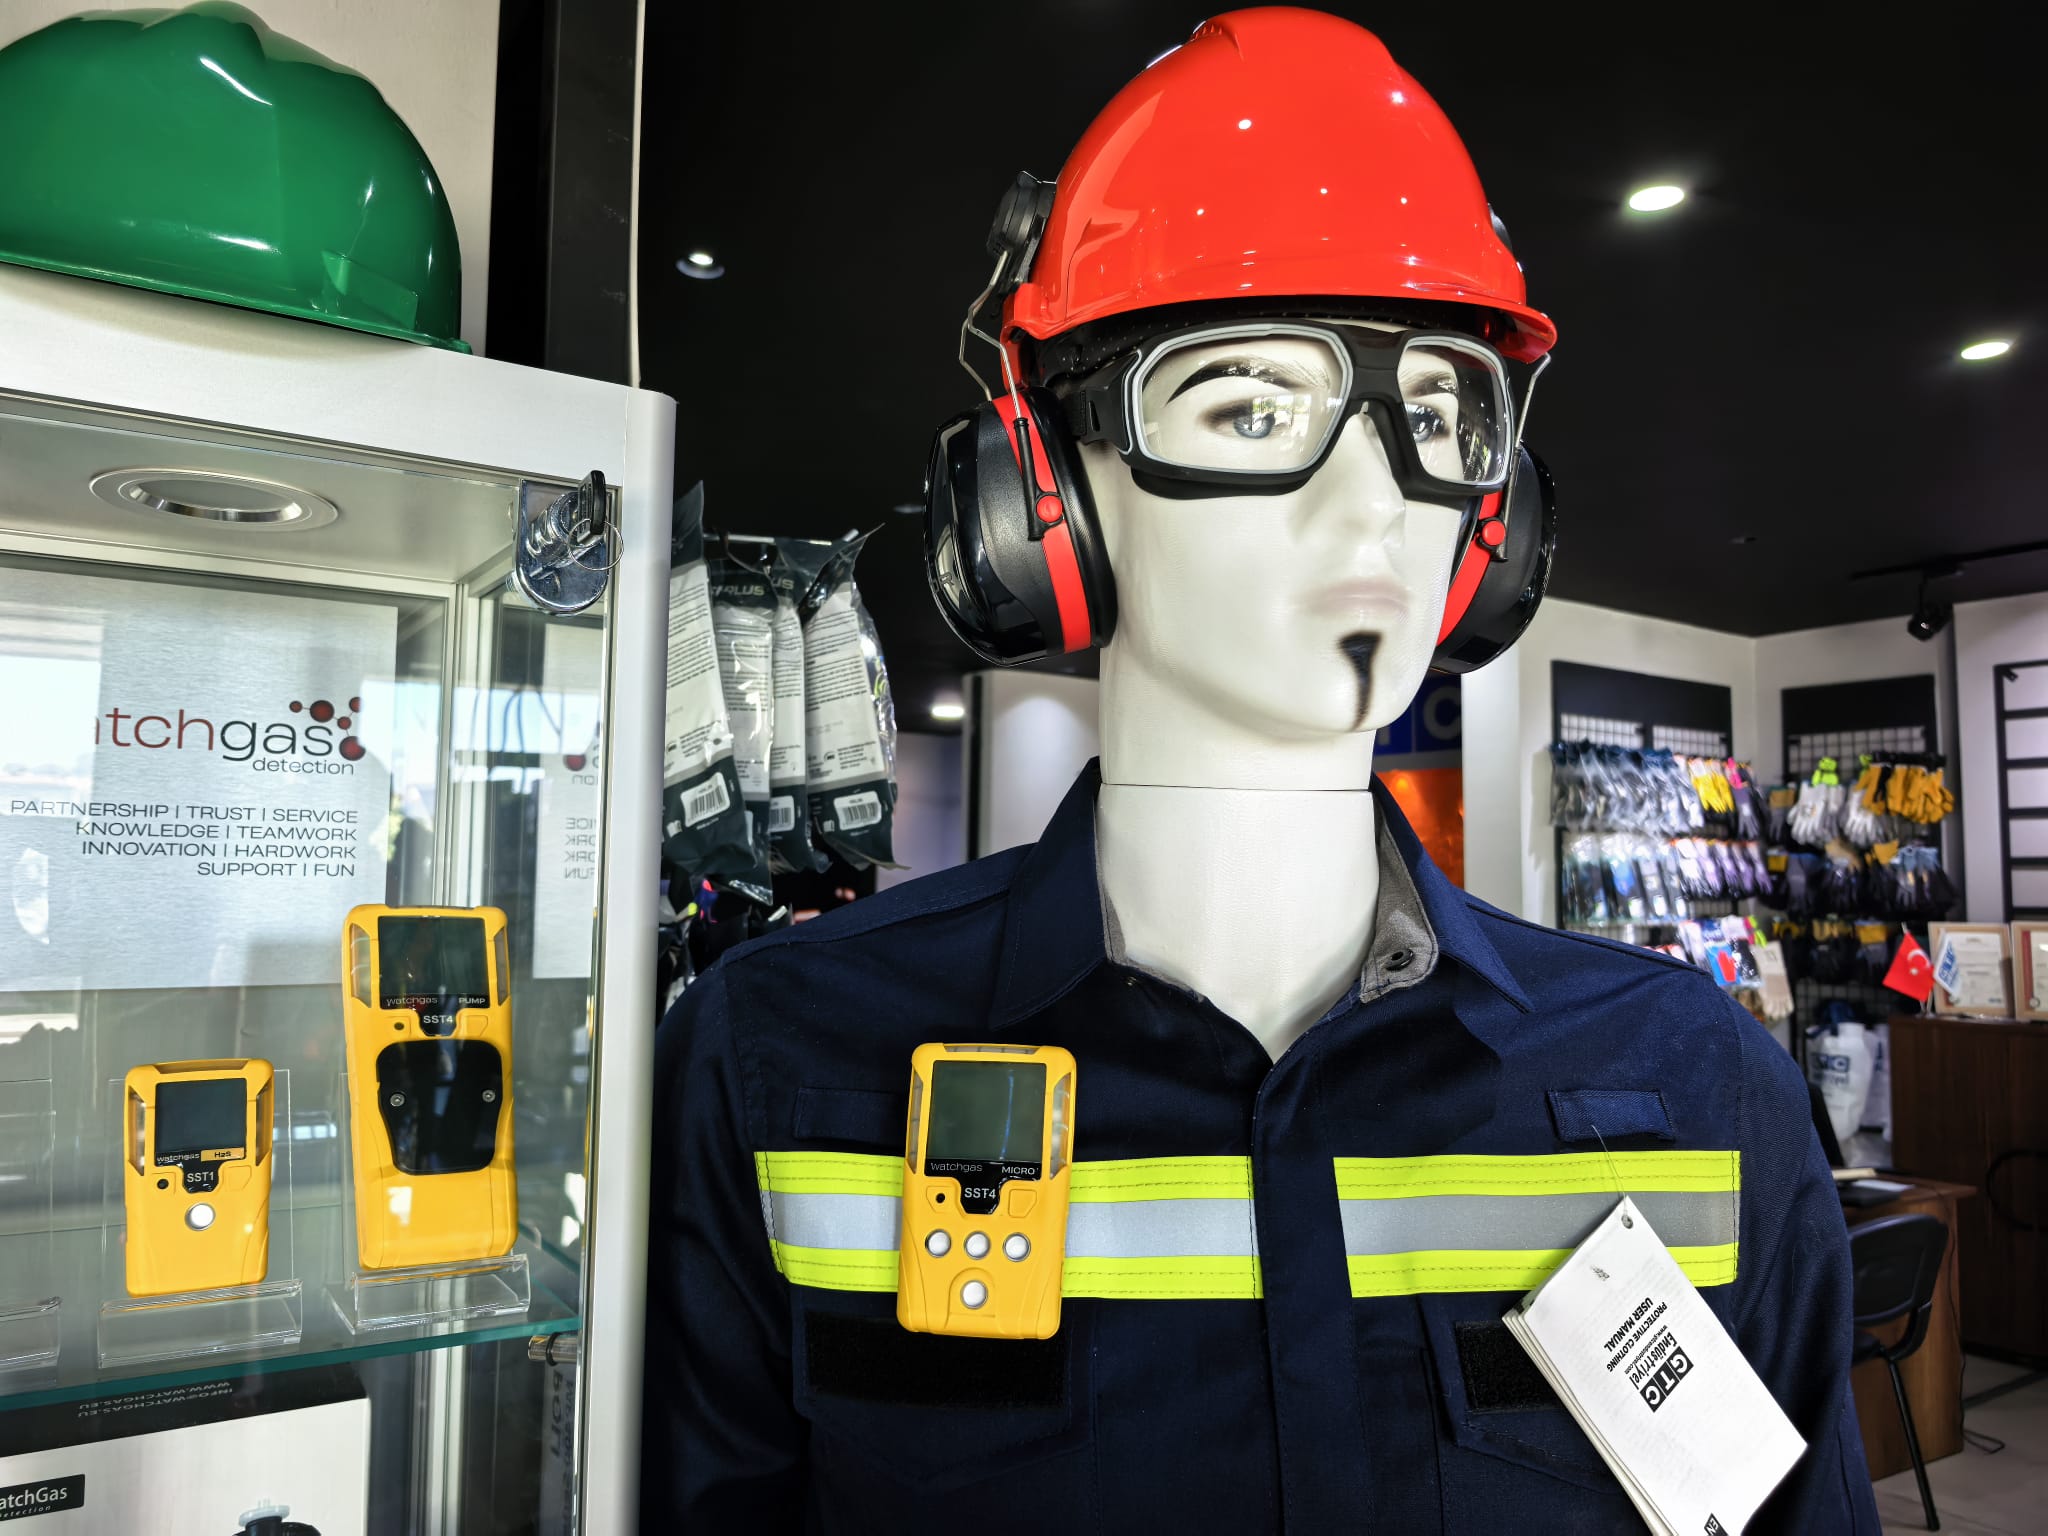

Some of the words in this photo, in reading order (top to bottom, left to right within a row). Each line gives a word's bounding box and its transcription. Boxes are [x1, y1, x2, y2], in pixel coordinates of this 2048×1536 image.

[252, 757, 355, 776] detection
[10, 799, 169, 818] PARTNERSHIP
[187, 805, 252, 821] TRUST
[272, 807, 358, 824] SERVICE
[76, 821, 220, 839] KNOWLEDGE
[236, 825, 357, 842] TEAMWORK
[82, 840, 216, 858] INNOVATION
[234, 843, 357, 860] HARDWORK
[197, 861, 297, 877] SUPPORT
[314, 863, 355, 877] FUN
[458, 997, 486, 1005] PUMP
[423, 1014, 454, 1024] SST4
[156, 1152, 200, 1163] watchgas
[186, 1170, 215, 1183] SST1
[930, 1161, 983, 1173] watchgas
[1001, 1165, 1036, 1176] MICRO
[963, 1186, 997, 1200] SST4
[1631, 1297, 1654, 1321] USER
[1632, 1301, 1668, 1342] PROTECTIVE
[1603, 1316, 1636, 1352] MANUAL
[1606, 1338, 1635, 1372] CLOTHING
[1628, 1331, 1678, 1390] Endüstriyel
[1643, 1351, 1690, 1407] GTC
